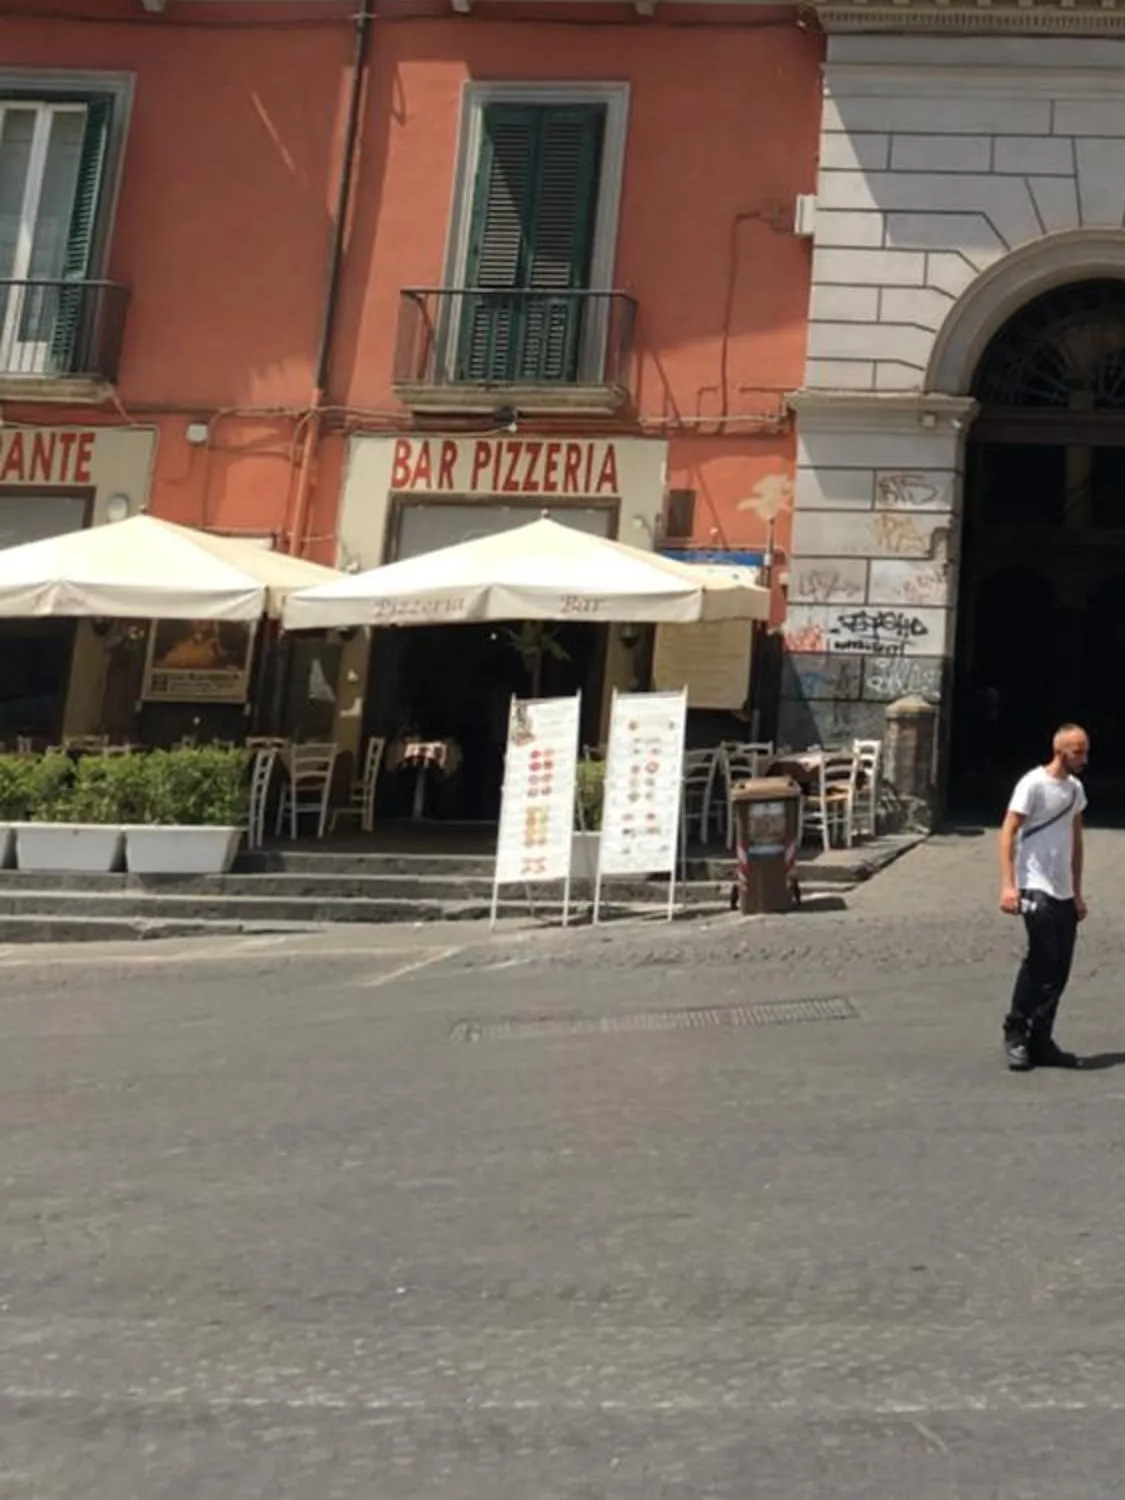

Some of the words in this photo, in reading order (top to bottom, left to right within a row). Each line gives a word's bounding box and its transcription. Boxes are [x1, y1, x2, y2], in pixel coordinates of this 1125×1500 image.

[0, 431, 96, 482] ANTE
[390, 437, 459, 490] BAR
[470, 440, 619, 493] PIZZERIA
